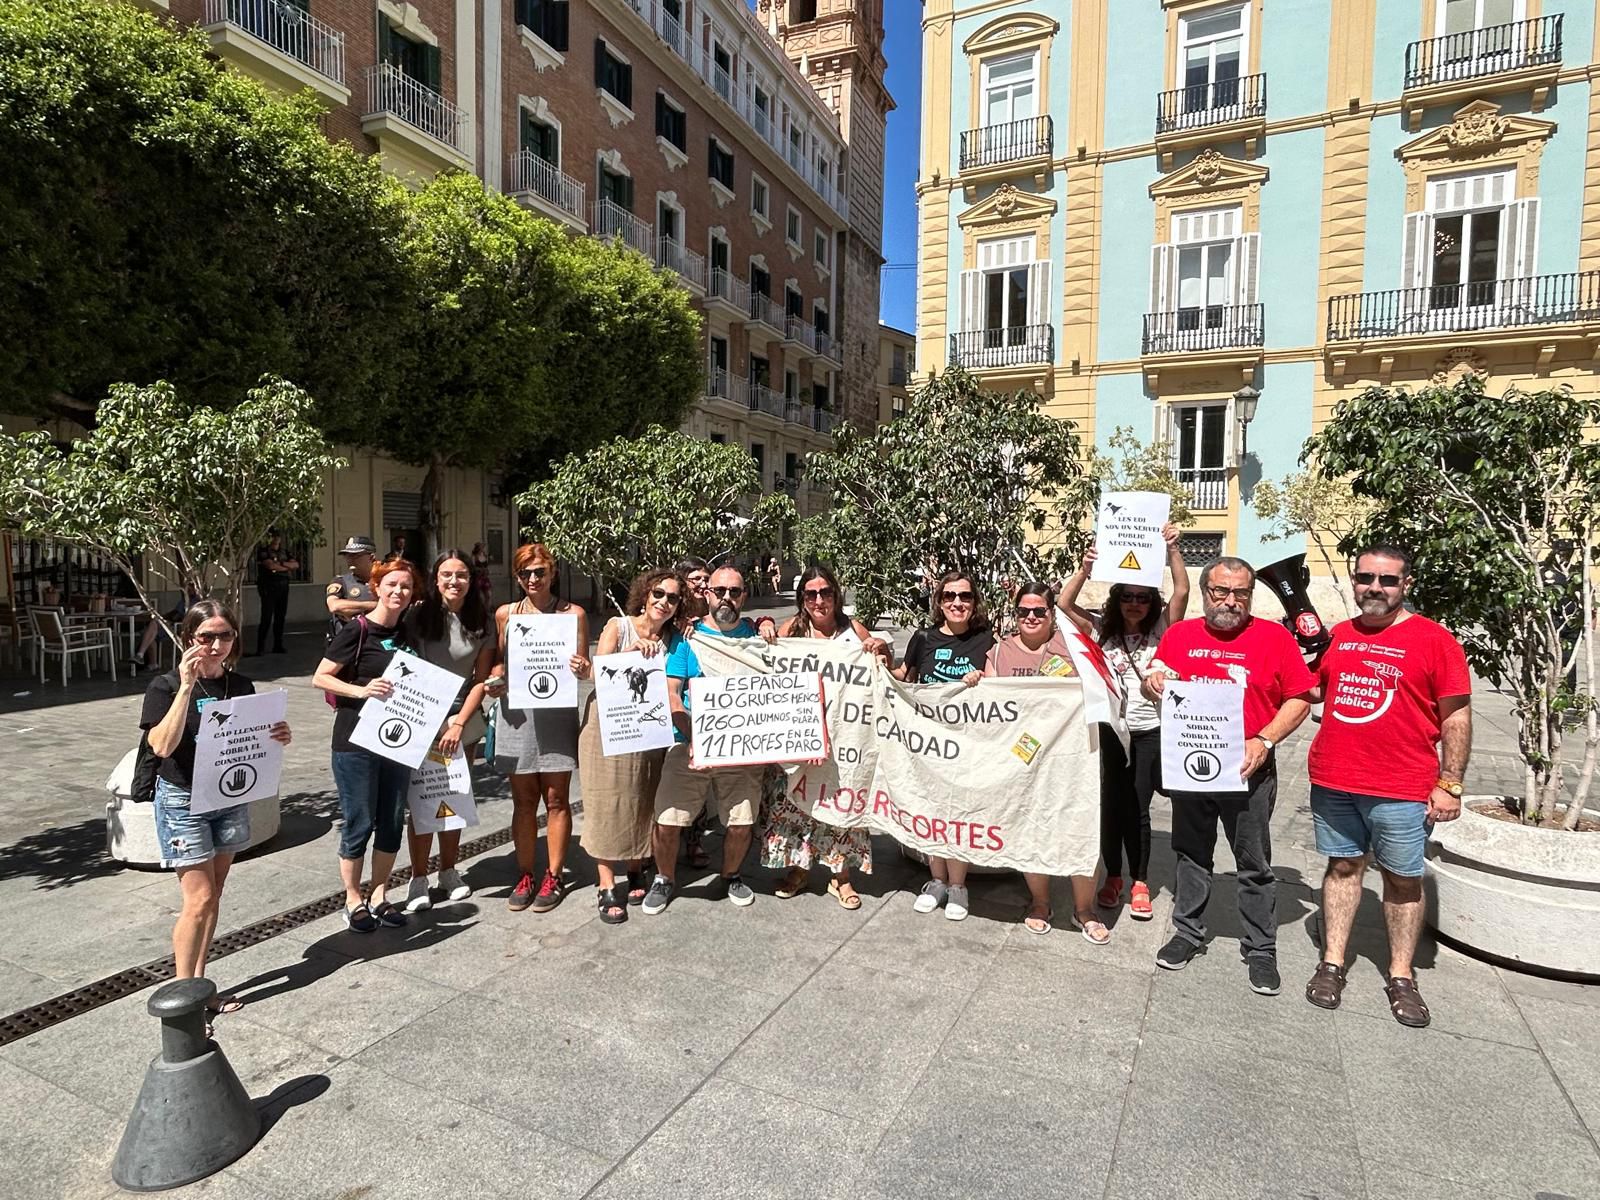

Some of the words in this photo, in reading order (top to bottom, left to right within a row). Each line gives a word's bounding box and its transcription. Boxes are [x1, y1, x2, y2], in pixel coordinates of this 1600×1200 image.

[1134, 525, 1160, 533] SERVEI
[1281, 580, 1294, 596] PYLE
[1188, 649, 1210, 658] UGT
[1338, 642, 1358, 651] UGT
[934, 661, 977, 675] LLENGUA
[1012, 668, 1033, 677] THE
[725, 675, 805, 691] ESPAÑOL
[1339, 672, 1380, 686] Salvem
[394, 682, 408, 691] CAP
[408, 688, 439, 705] LLENGUA
[1337, 683, 1380, 698] l'escola
[704, 693, 733, 708] 40
[735, 692, 789, 708] GRUPOS
[1334, 695, 1375, 710] pública
[392, 699, 416, 714] SOBRA
[416, 710, 425, 718] EL
[796, 707, 812, 715] SIN
[843, 702, 873, 726] DE
[915, 701, 1018, 725] IDIOMAS
[385, 706, 426, 727] CONSELLER!
[695, 714, 746, 734] 1260
[746, 712, 790, 726] ALUMNOS
[792, 715, 819, 724] PLAZA
[213, 730, 232, 739] CAP
[234, 724, 271, 735] LLENGUA
[787, 729, 801, 738] EN
[804, 729, 818, 737] EL
[1181, 732, 1209, 740] SOBRA
[228, 735, 258, 745] SOBRA,
[702, 734, 727, 758] 11
[730, 733, 784, 756] PROFES
[785, 739, 822, 754] PARO
[1178, 741, 1228, 749] CONSELLER!
[214, 751, 267, 766] CONSELLER!
[219, 745, 249, 757] SOBRA
[838, 747, 862, 764] EOI
[792, 774, 807, 801] A
[818, 784, 868, 814] LOS
[873, 790, 1004, 851] RECORTES
